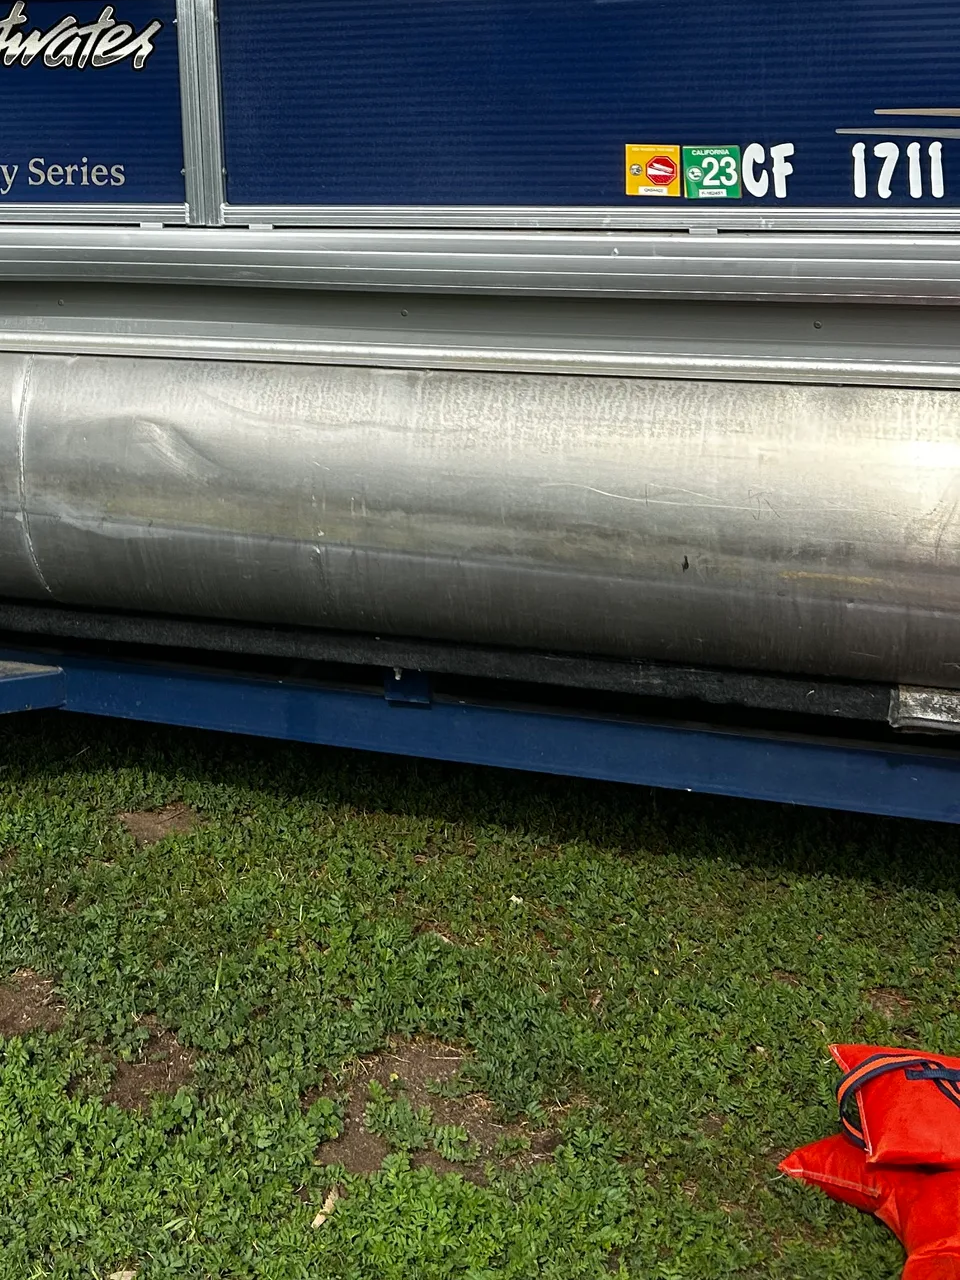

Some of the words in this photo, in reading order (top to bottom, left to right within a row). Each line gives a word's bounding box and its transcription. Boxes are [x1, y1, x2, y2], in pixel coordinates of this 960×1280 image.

[28, 157, 126, 186] Series
[701, 156, 738, 186] 23
[742, 142, 795, 199] CF
[851, 141, 945, 199] 1711
